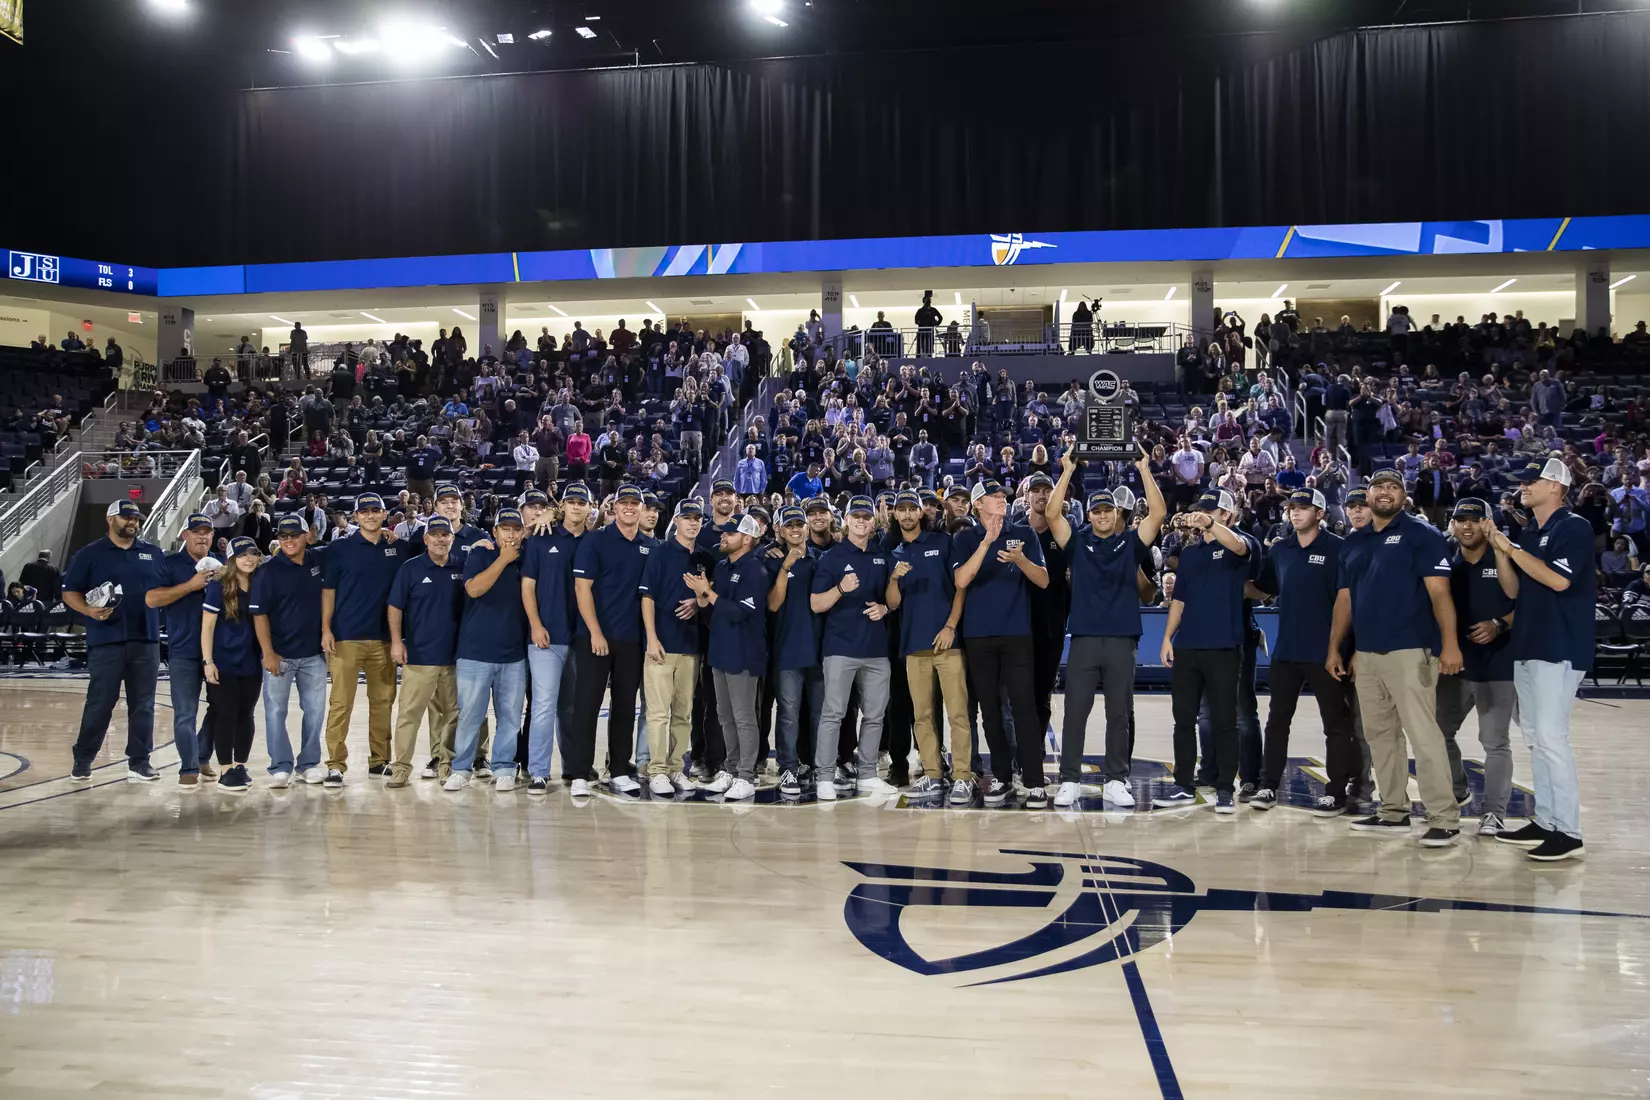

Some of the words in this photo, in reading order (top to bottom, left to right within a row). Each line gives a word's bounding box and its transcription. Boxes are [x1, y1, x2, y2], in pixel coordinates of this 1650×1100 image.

[98, 264, 113, 275] TOL
[128, 268, 133, 277] 3
[98, 277, 112, 287] FLS
[128, 281, 133, 290] 0
[1094, 380, 1116, 389] WAC
[924, 549, 939, 557] CBU
[1309, 554, 1325, 562] CBU
